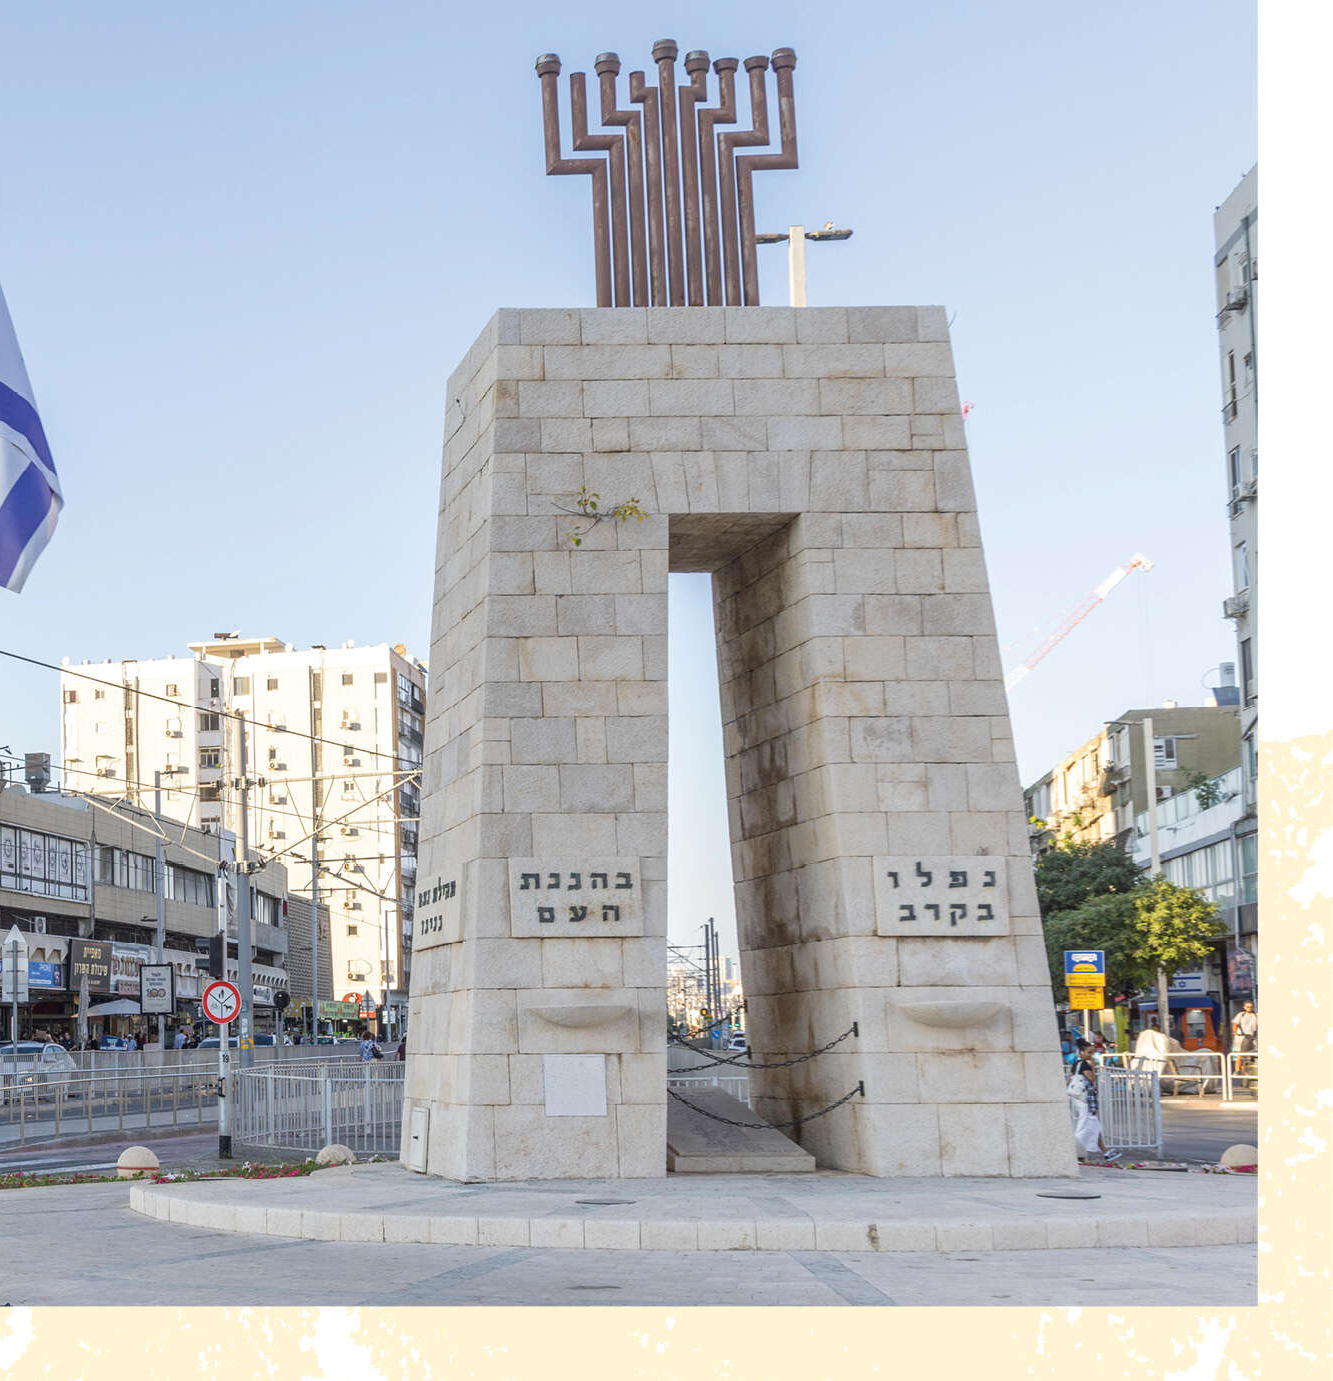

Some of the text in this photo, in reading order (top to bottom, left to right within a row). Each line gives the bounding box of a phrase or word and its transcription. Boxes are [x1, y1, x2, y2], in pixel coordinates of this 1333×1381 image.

[519, 872, 633, 891] בהגנת
[887, 861, 996, 888] נפלו
[537, 904, 620, 923] העם
[899, 904, 995, 926] בקרב
